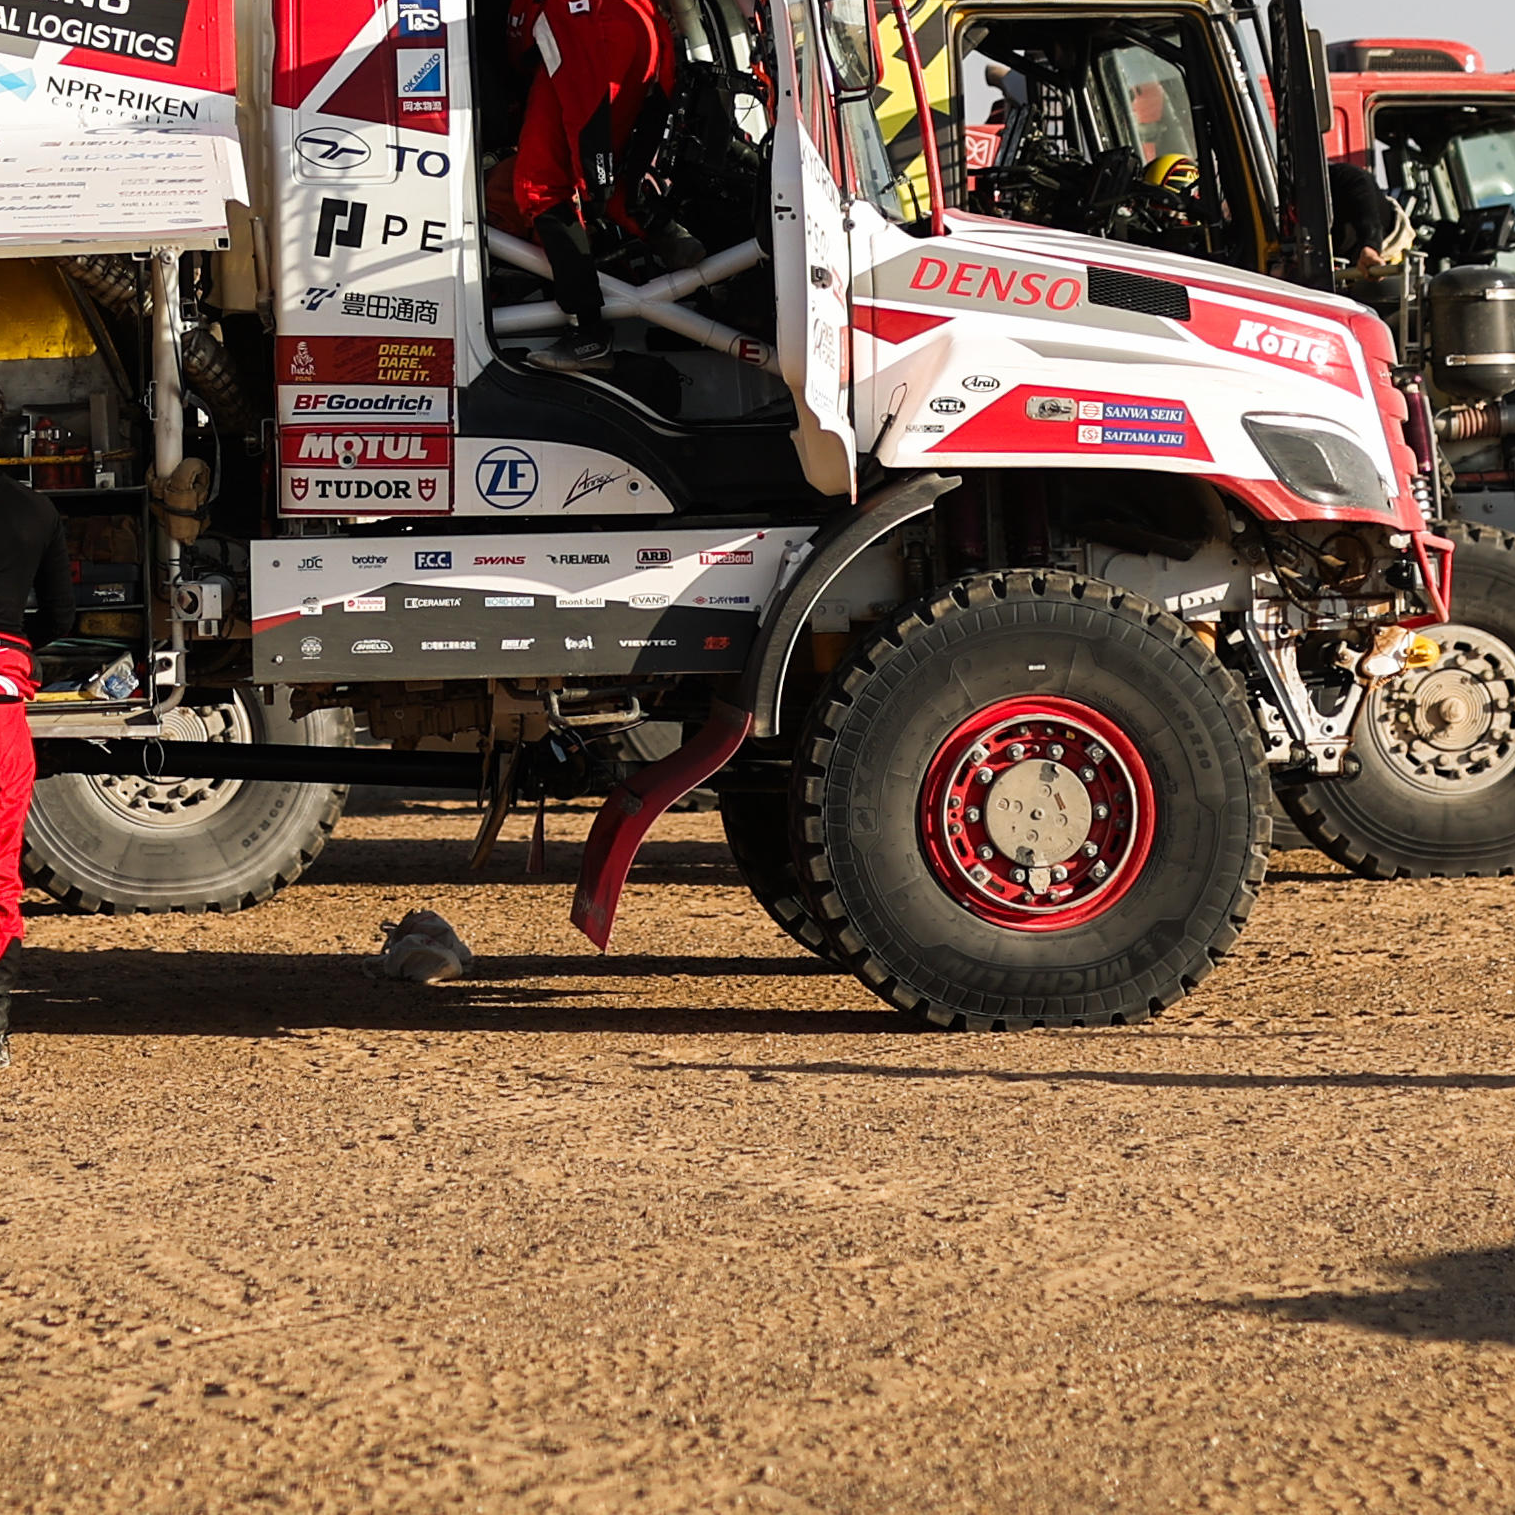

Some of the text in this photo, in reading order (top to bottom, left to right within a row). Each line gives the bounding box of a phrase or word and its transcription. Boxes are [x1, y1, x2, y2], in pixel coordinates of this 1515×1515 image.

[399, 9, 440, 31] T&S
[27, 11, 174, 62] LOGISTICS
[403, 53, 441, 93] OKAMOTO
[46, 76, 199, 120] NPR-RIKEN
[385, 144, 451, 178] TO
[909, 256, 1082, 311] DENSO
[341, 292, 440, 325] 豊田通商
[378, 344, 436, 356] DREAM.
[378, 357, 422, 368] DARE.
[378, 370, 430, 381] LIVE IT.
[294, 394, 433, 411] BFGoodrich
[932, 401, 965, 412] KTEL
[1105, 406, 1183, 422] SANWA SEIKI
[1104, 430, 1183, 445] SAITAMA KIKI
[298, 432, 428, 460] MOTUL
[483, 459, 532, 496] ZF
[315, 480, 412, 499] TUDOR
[352, 555, 388, 565] brother
[417, 554, 450, 567] F.C.C.
[473, 556, 526, 565] SWANS
[641, 552, 668, 561] ARB
[700, 552, 752, 564] ThreeBond
[619, 639, 677, 647] VIEWTEC
